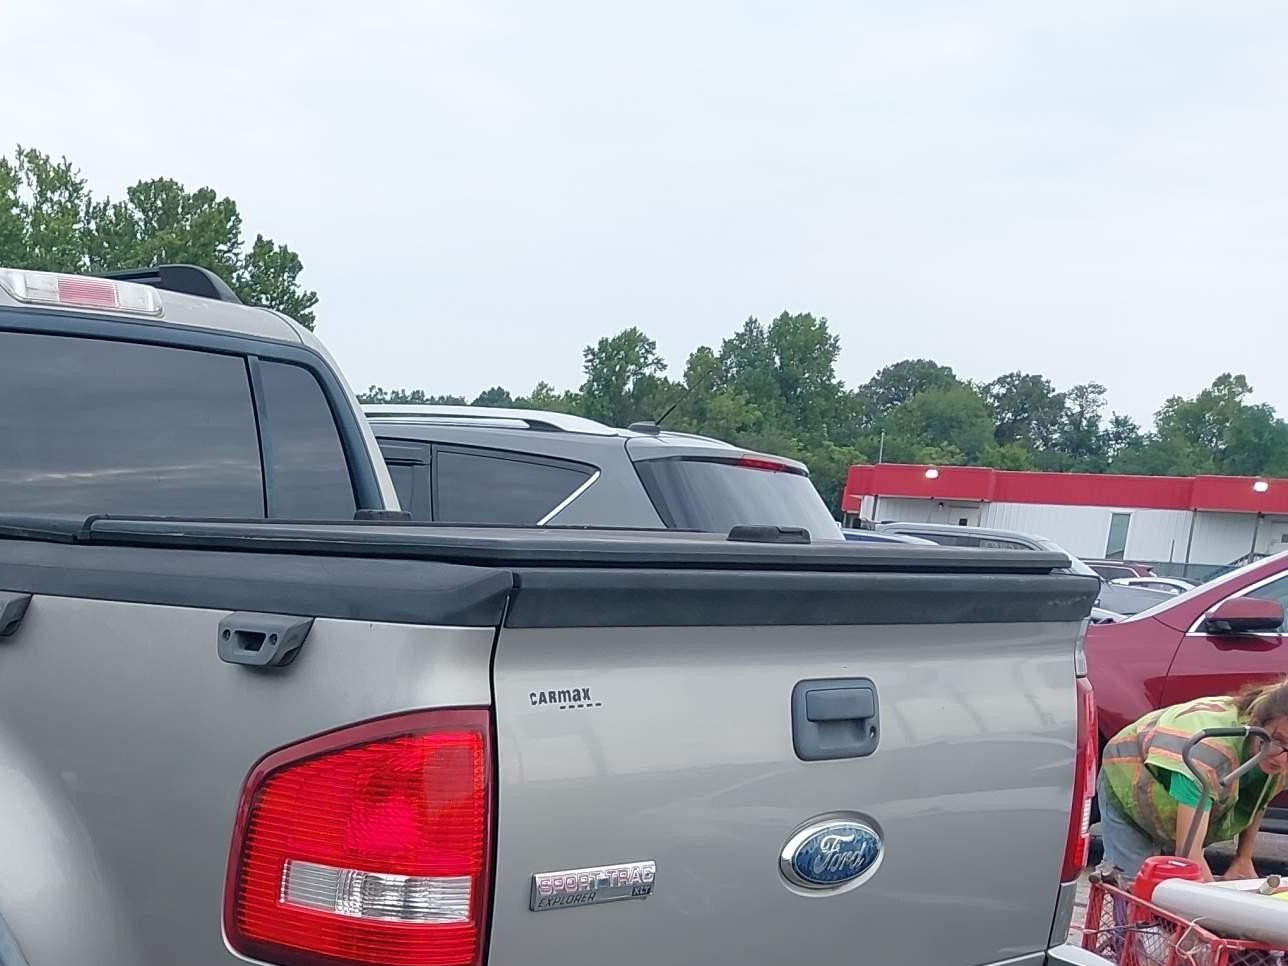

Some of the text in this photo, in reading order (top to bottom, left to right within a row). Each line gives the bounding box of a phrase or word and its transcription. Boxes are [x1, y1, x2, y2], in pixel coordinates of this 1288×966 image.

[813, 834, 867, 874] Ford
[538, 865, 654, 896] SPORT TRAC
[632, 885, 651, 897] XLT
[537, 891, 597, 909] EXPLORER
